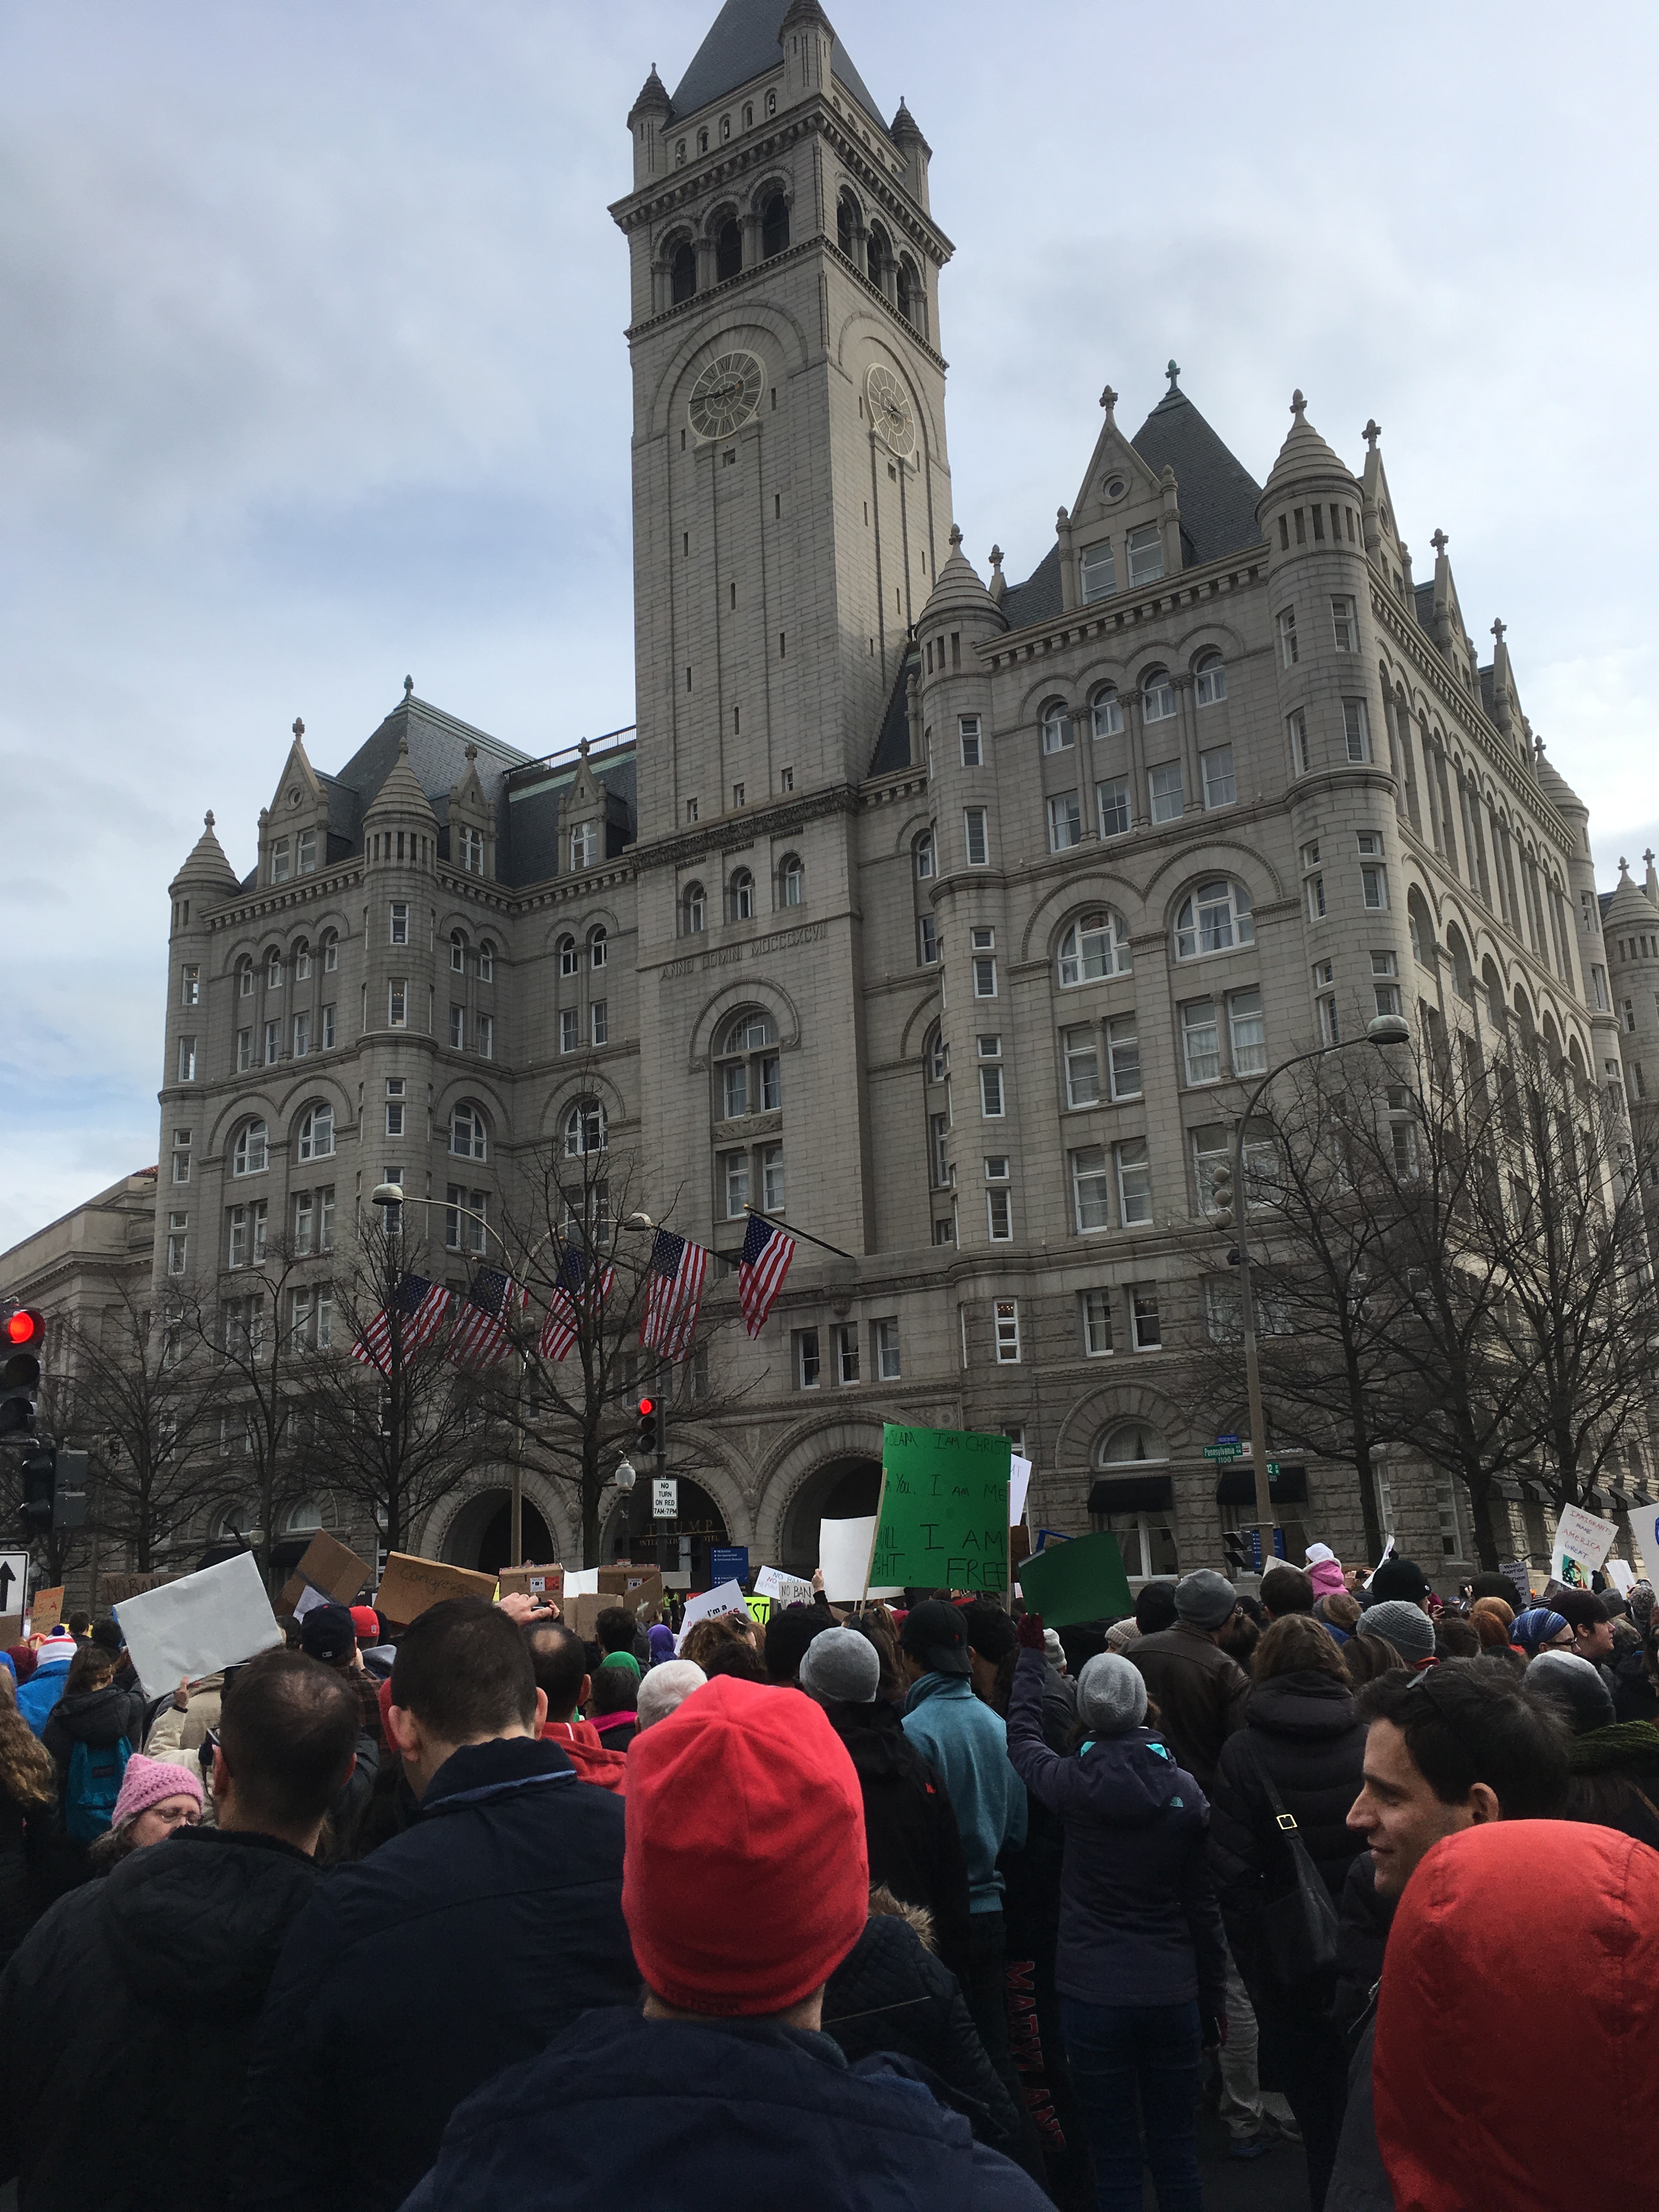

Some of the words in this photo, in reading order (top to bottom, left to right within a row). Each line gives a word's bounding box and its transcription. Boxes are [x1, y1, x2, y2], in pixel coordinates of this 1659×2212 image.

[660, 960, 694, 982] ANNO
[702, 946, 743, 970] DOMINI
[933, 1432, 946, 1449] I
[945, 1436, 960, 1449] AM
[966, 1435, 1011, 1455] CHRIST
[1266, 1464, 1273, 1473] 12
[931, 1474, 941, 1496] I
[952, 1486, 969, 1497] AM
[984, 1483, 1008, 1502] ME
[646, 1519, 713, 1536] TUMP
[1570, 1510, 1612, 1535] IMMIGRANTS
[1576, 1523, 1592, 1534] MAKE
[919, 1523, 944, 1550] I
[962, 1530, 1003, 1558] AM
[1562, 1528, 1600, 1551] AMERICA
[1565, 1541, 1589, 1559] GREAT
[772, 1572, 783, 1580] NO
[947, 1558, 1008, 1592] FREE
[781, 1585, 790, 1596] NO
[794, 1585, 811, 1599] BAN
[707, 1607, 720, 1617] I'm
